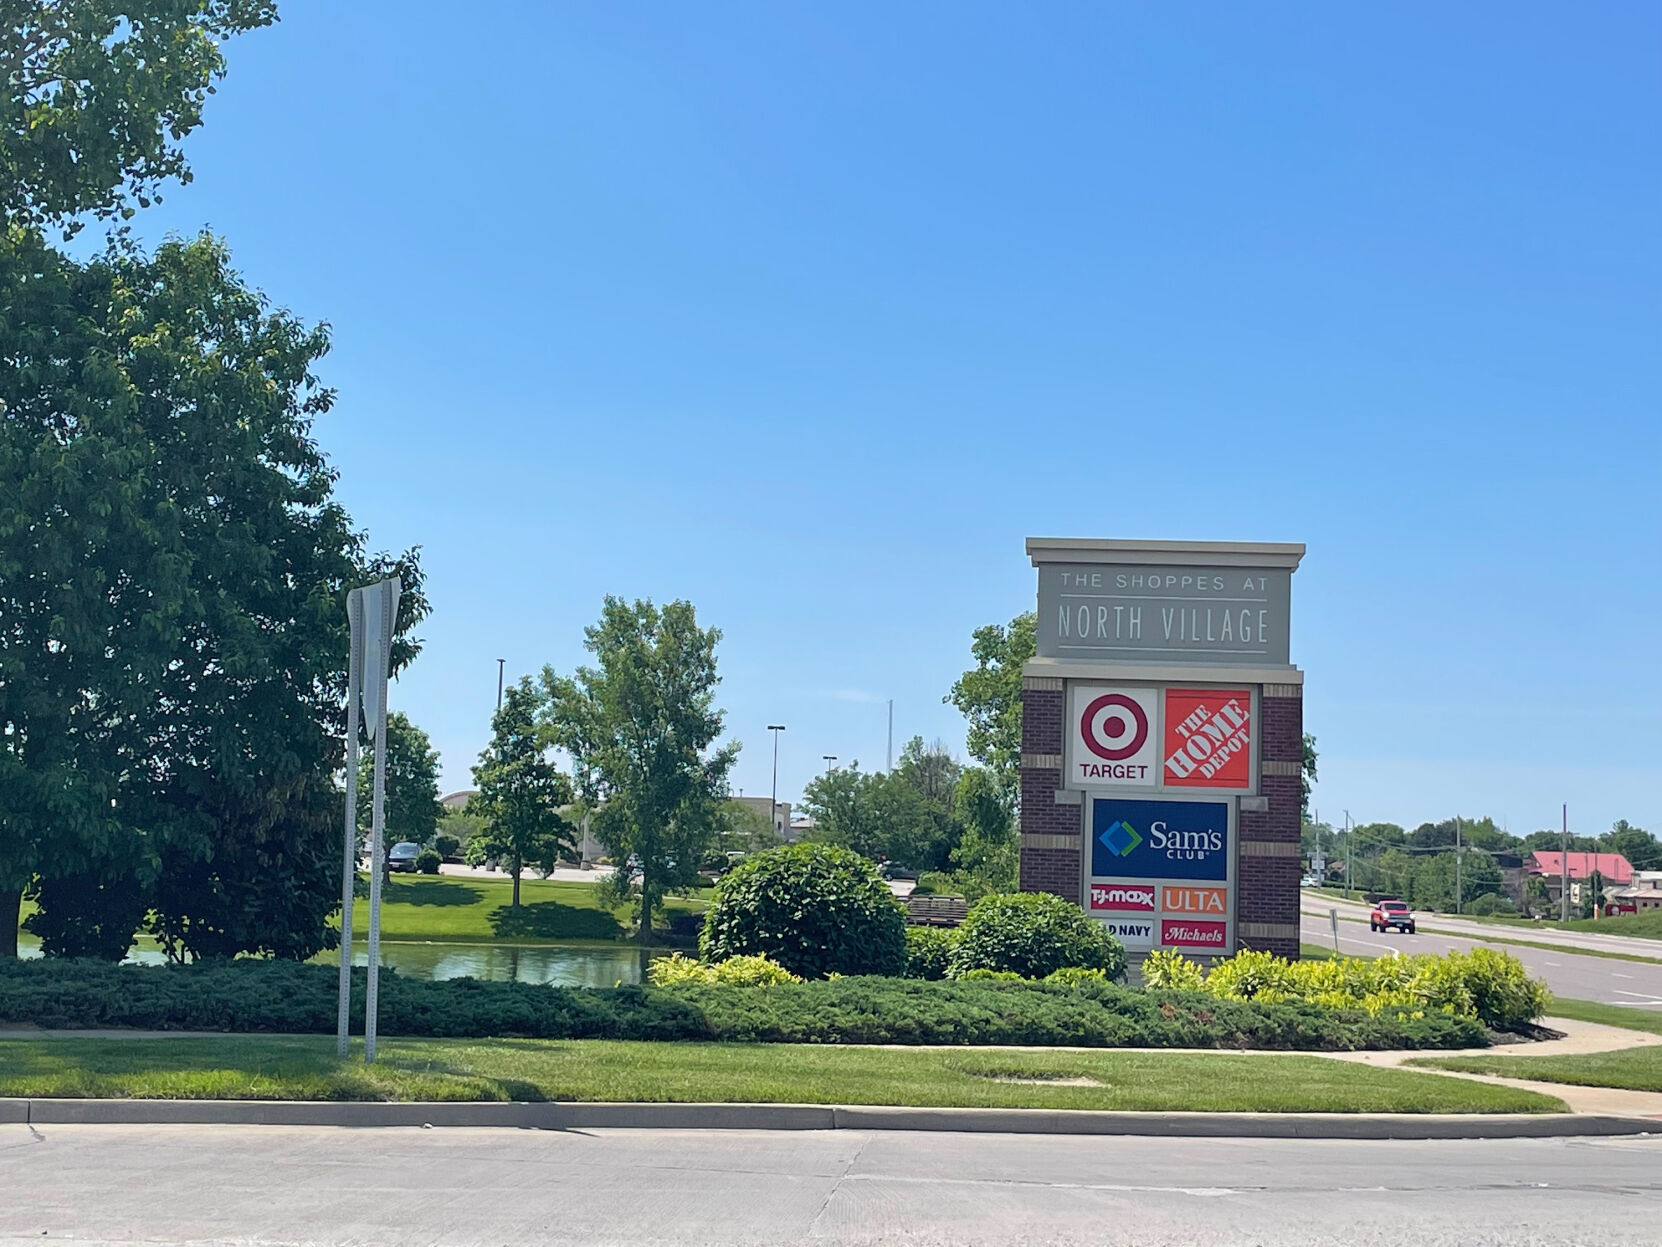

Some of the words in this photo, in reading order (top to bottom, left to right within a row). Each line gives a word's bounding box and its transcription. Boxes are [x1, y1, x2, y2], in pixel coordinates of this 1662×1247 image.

[1061, 573, 1103, 588] THE
[1116, 574, 1224, 591] SHOPPES
[1243, 577, 1268, 591] AT
[1058, 605, 1142, 639] NORTH
[1162, 608, 1268, 643] VILLAGE
[1175, 704, 1211, 739] THE
[1165, 699, 1250, 778] HOME
[1199, 728, 1249, 779] DEPOT
[1080, 763, 1148, 779] TARGET
[1150, 821, 1222, 851] Sam's
[1167, 850, 1205, 859] CLUB
[1165, 890, 1224, 911] ULTA
[1119, 925, 1151, 937] NAVY
[1165, 927, 1223, 942] Michaels
